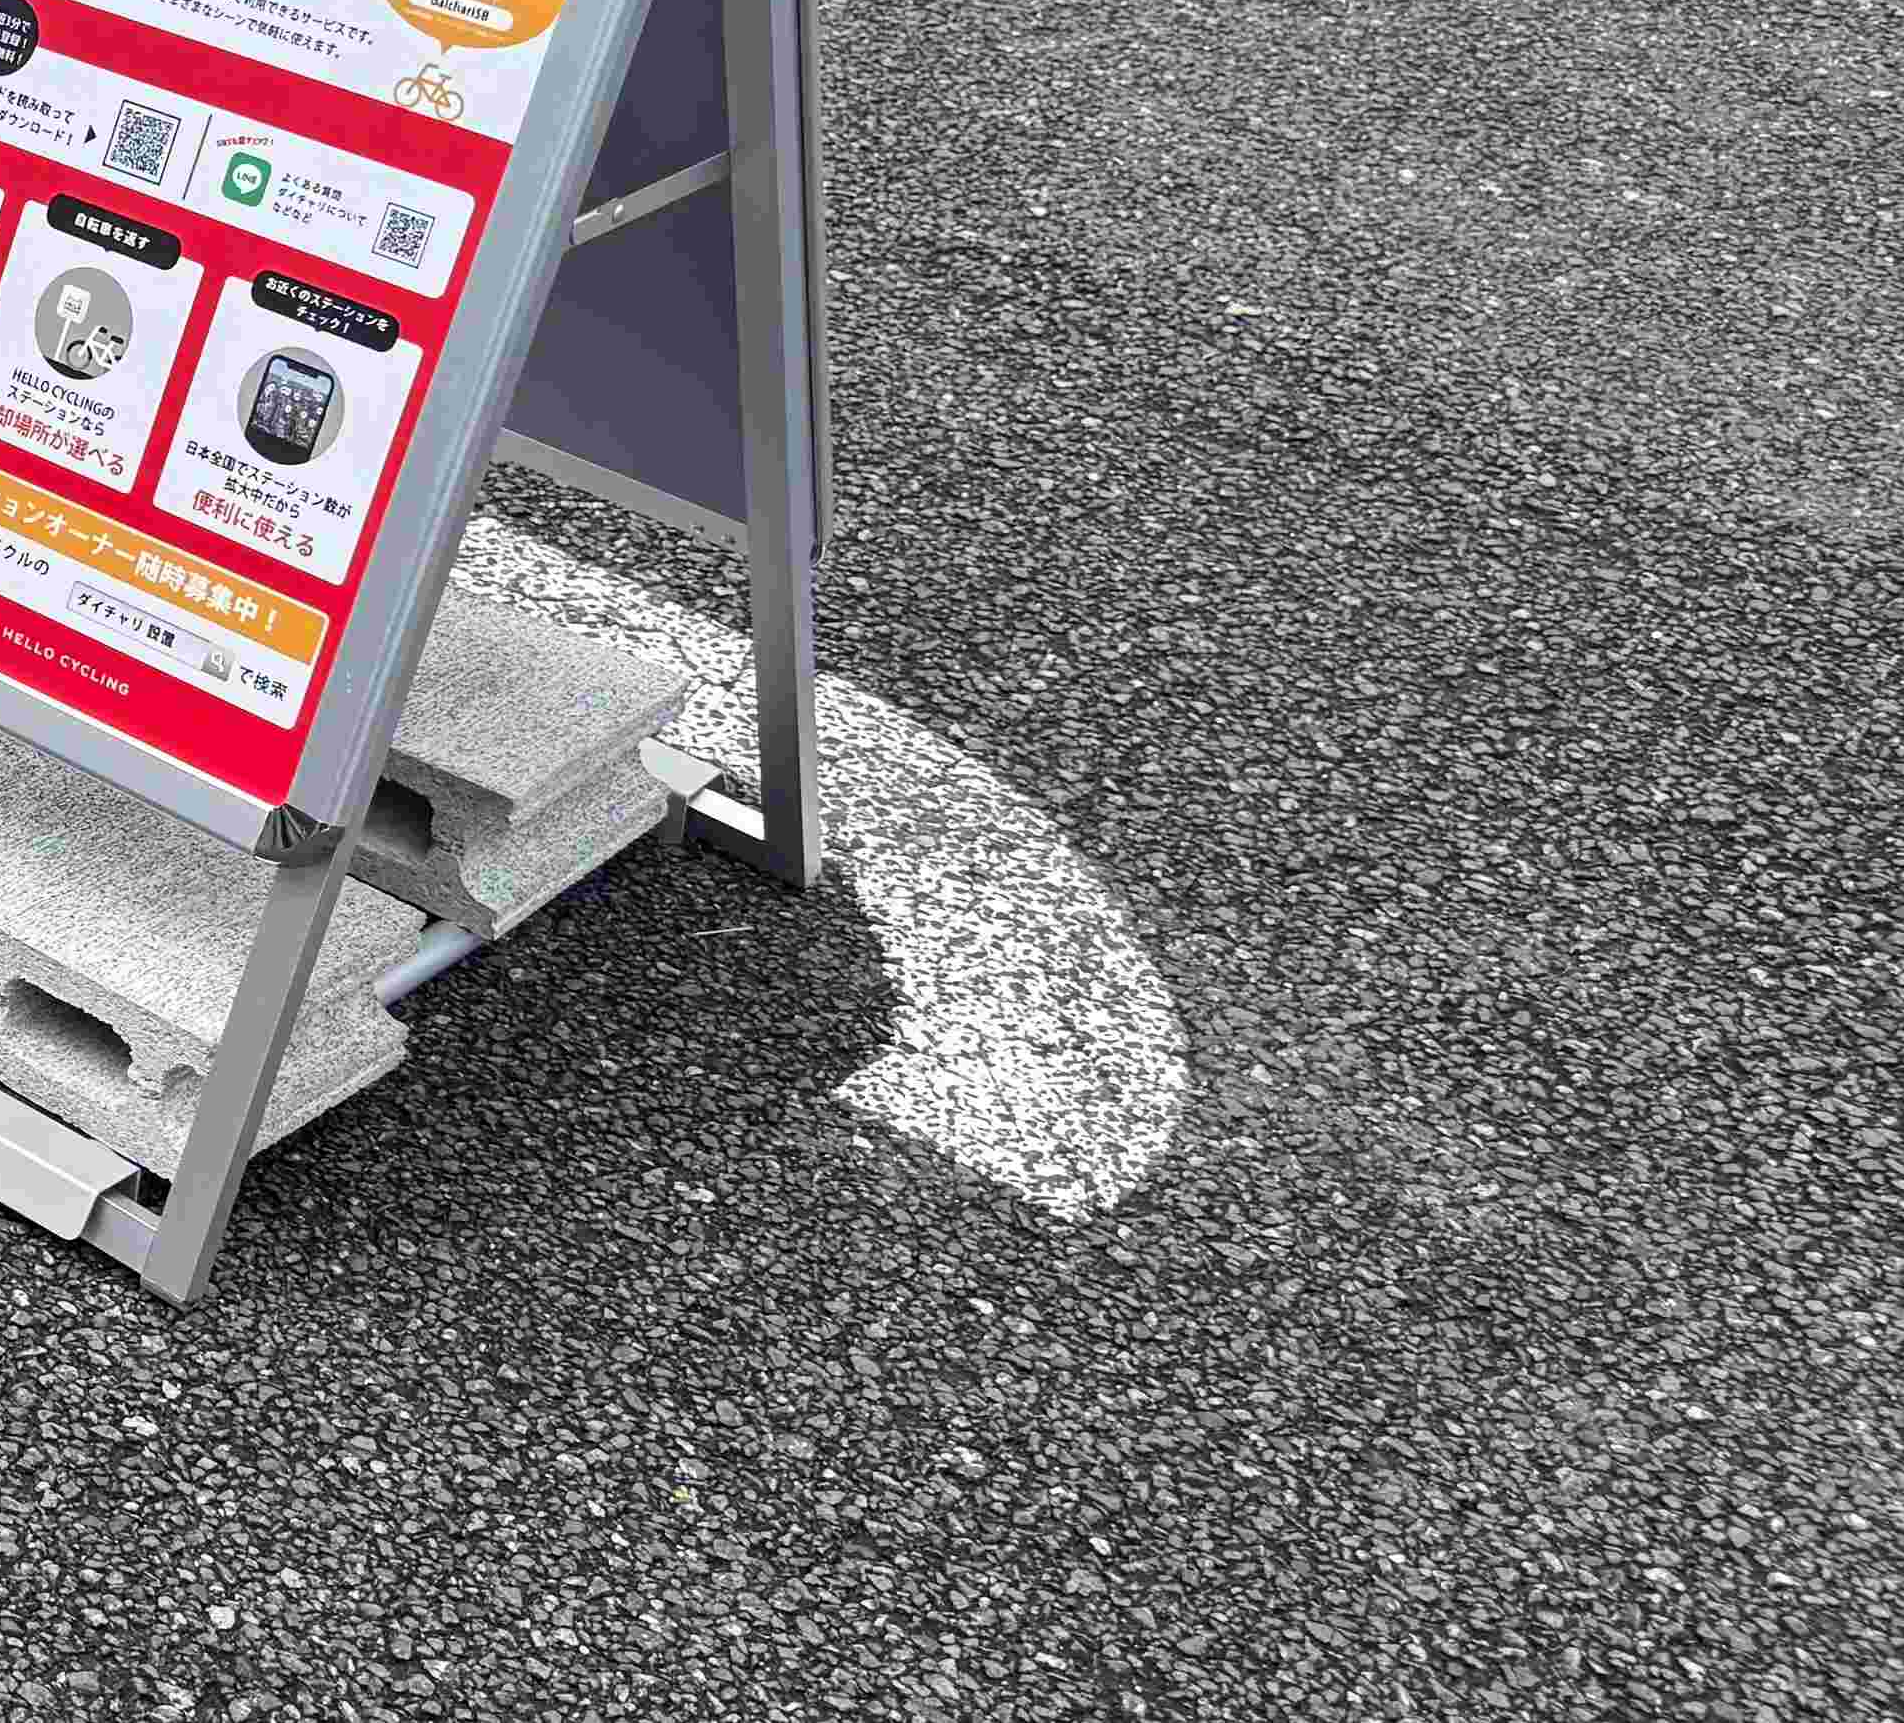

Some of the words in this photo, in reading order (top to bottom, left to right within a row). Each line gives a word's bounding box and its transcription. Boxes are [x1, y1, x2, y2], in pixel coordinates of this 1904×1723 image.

[237, 171, 258, 185] LINE
[281, 172, 343, 202] よくある質問
[73, 212, 153, 251] 自転車を返す
[273, 201, 313, 225] などなど
[278, 187, 368, 227] ダイチャリについて
[264, 276, 391, 333] お近くのステーションを
[6, 384, 105, 437] ステーションなら
[11, 366, 50, 394] HELLO
[51, 382, 116, 421] CYCLINGの
[185, 439, 353, 520] 日本全国でステーション数が
[192, 488, 315, 559] 便利に使える
[76, 591, 144, 633] ダイチャリ
[145, 623, 176, 650] 設置
[2, 626, 55, 661] HELLO
[59, 653, 131, 697] CYCLING
[239, 666, 289, 702] で検索
